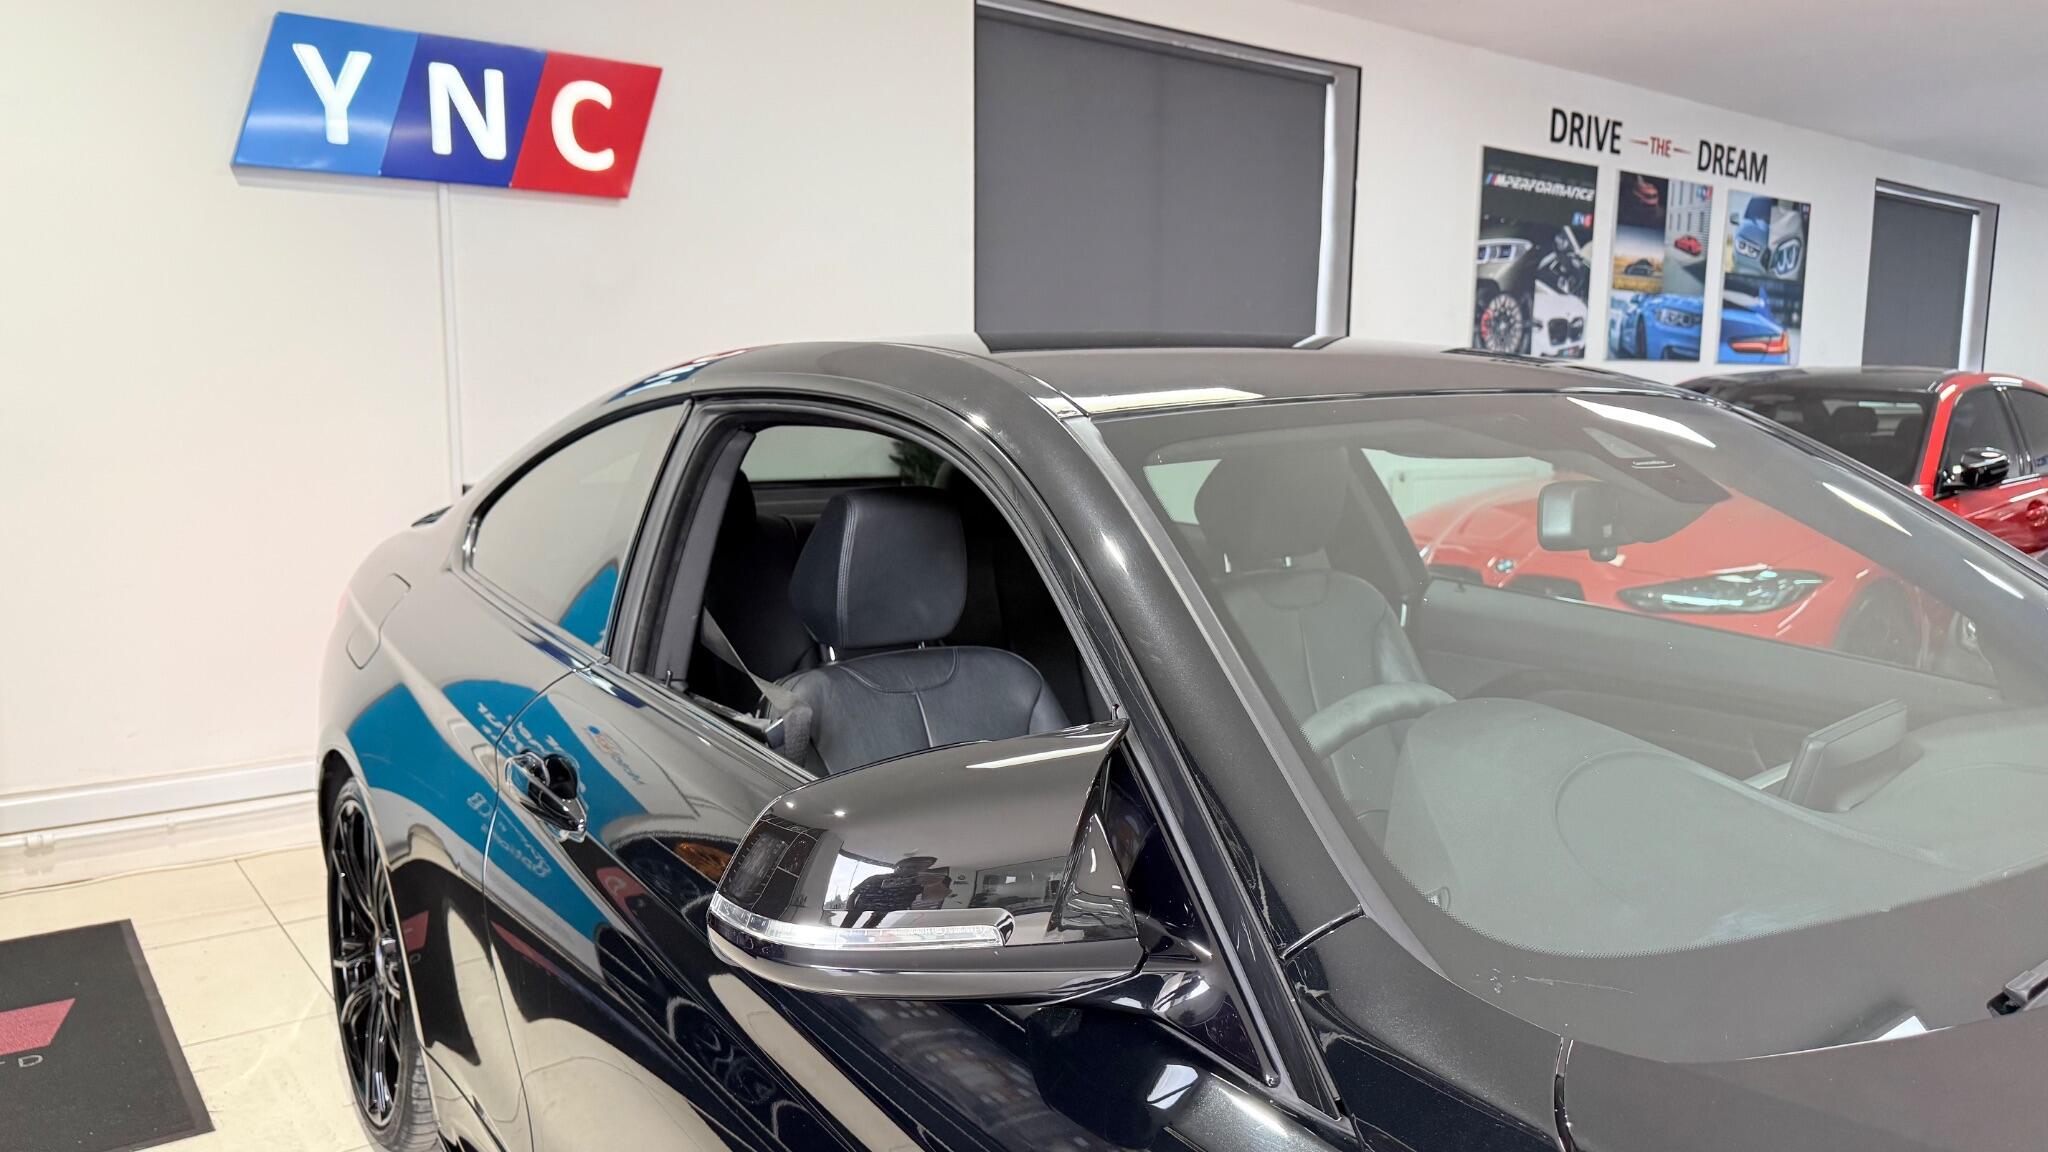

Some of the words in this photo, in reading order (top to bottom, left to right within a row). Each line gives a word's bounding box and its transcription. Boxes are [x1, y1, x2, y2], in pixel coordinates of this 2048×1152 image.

[292, 43, 615, 171] YNC
[1550, 108, 1622, 154] DRIVE
[1650, 137, 1671, 157] THE
[1697, 140, 1768, 184] DREAM
